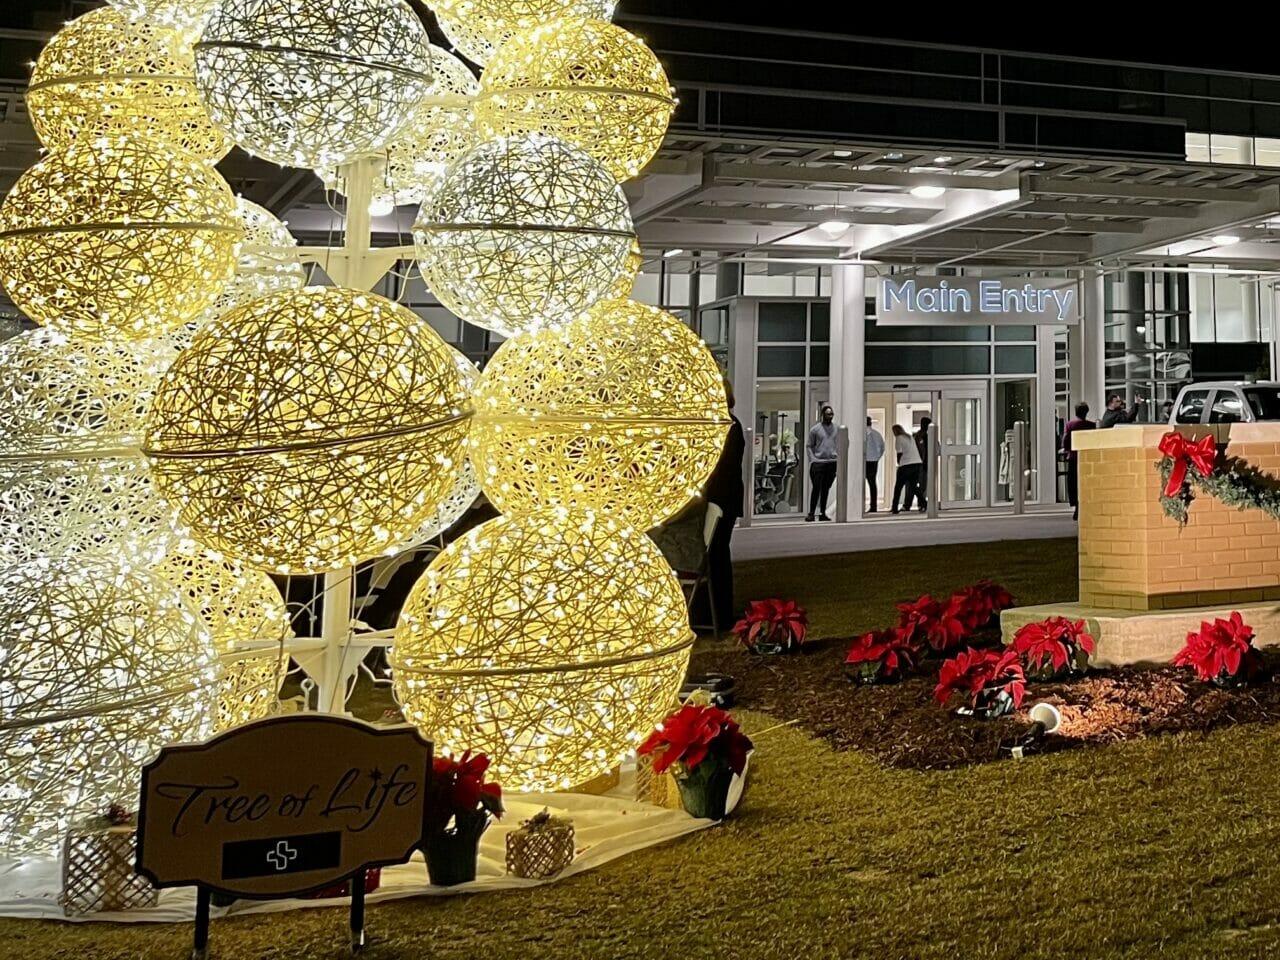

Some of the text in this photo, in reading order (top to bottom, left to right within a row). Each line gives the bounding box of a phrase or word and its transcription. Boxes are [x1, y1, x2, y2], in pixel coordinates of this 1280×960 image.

[883, 279, 1073, 320] Main Entry
[155, 763, 418, 837] Tree of Life
